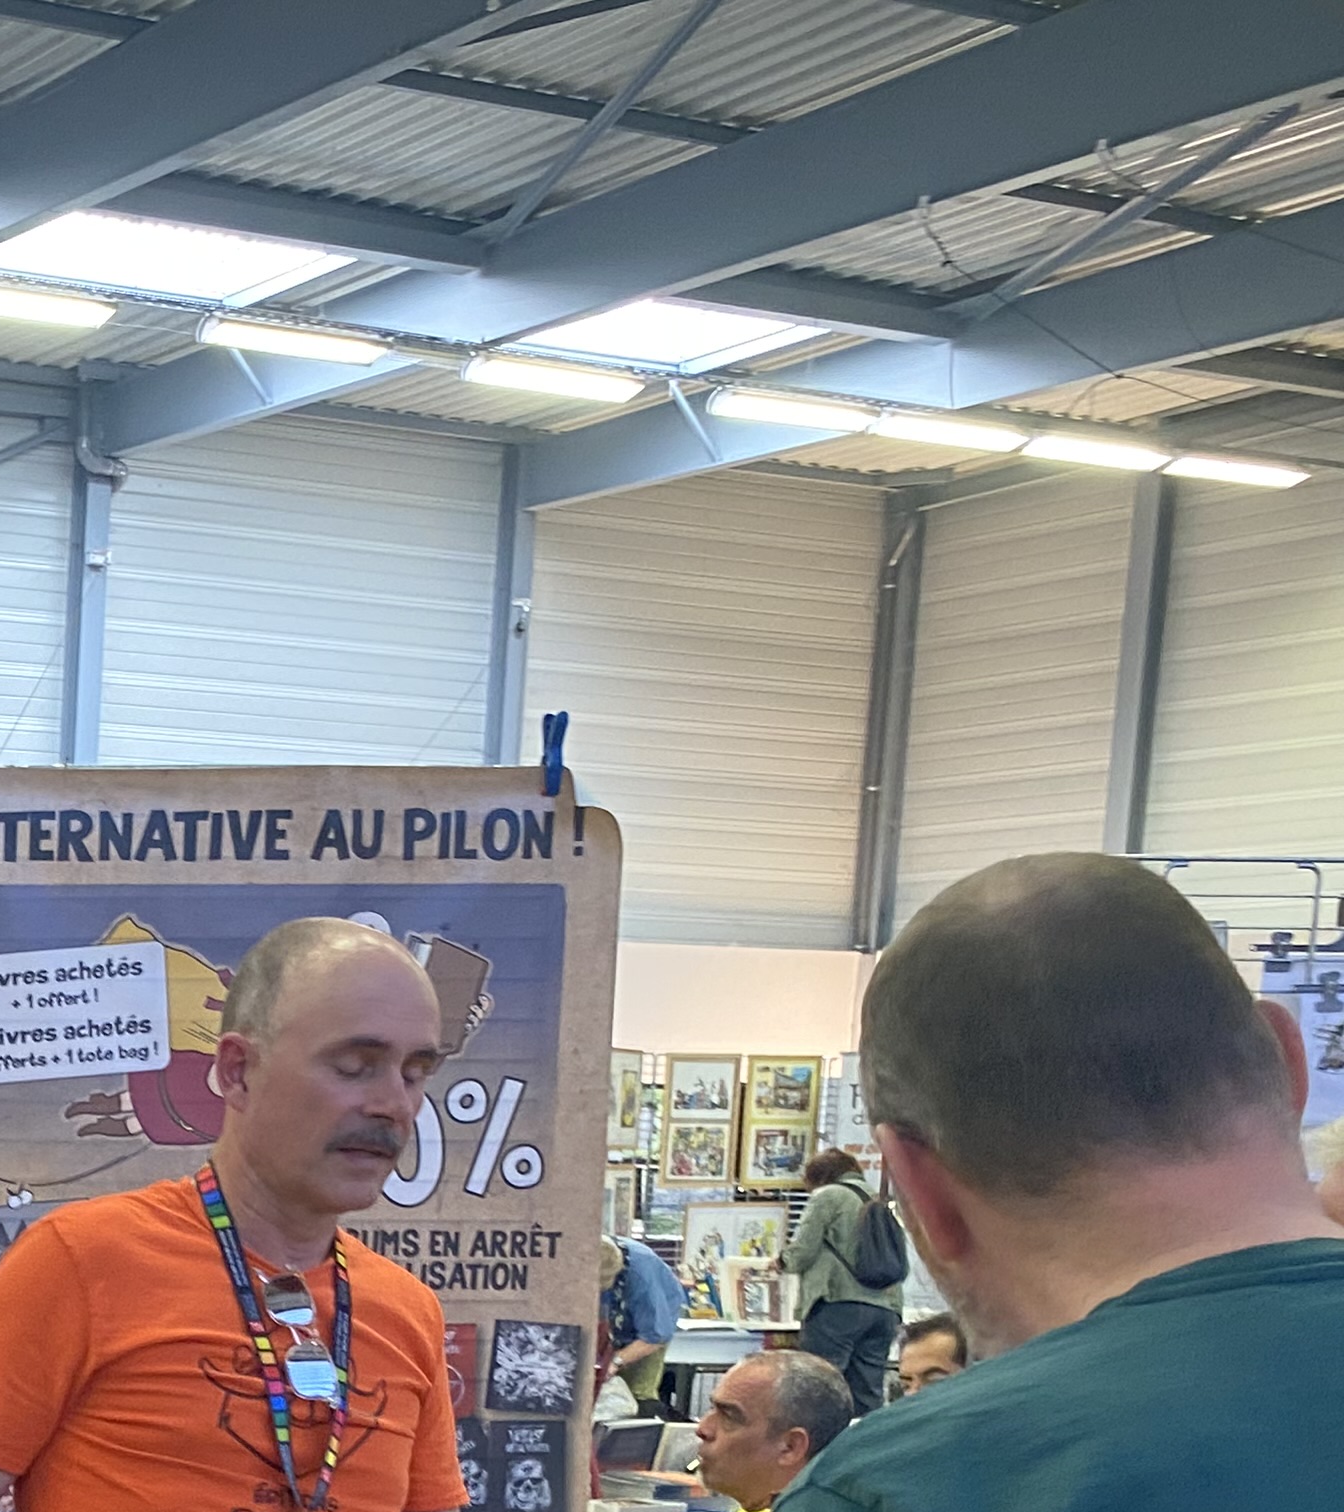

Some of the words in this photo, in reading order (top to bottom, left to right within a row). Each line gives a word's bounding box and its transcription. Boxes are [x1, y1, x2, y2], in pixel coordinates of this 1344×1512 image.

[310, 807, 385, 862] AU
[401, 805, 554, 862] PILON
[572, 804, 585, 857] !
[55, 956, 143, 983] achetés
[63, 1014, 153, 1040] achetés
[429, 1230, 461, 1258] EN
[469, 1222, 562, 1259] ARRÊT
